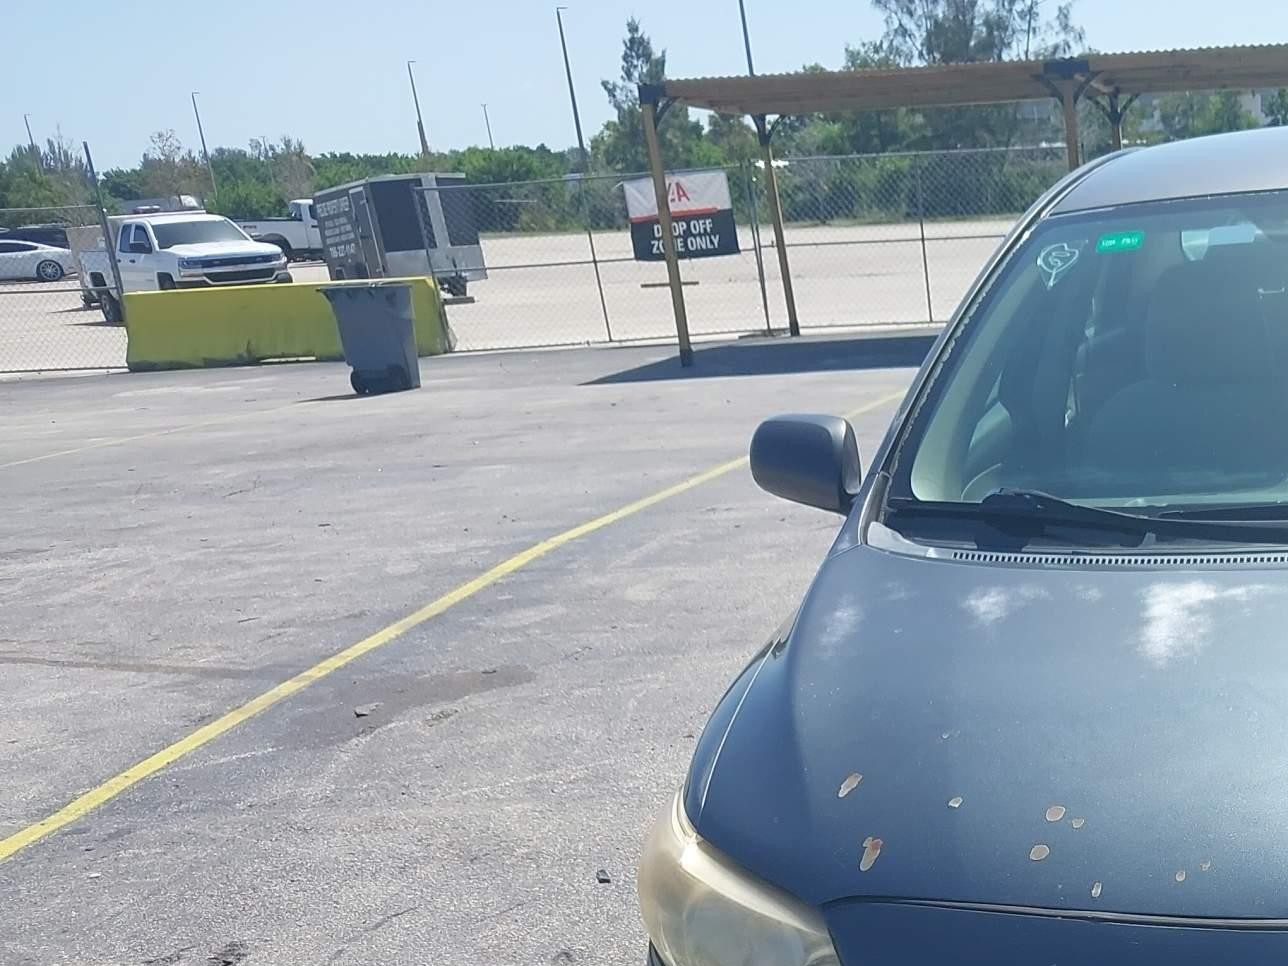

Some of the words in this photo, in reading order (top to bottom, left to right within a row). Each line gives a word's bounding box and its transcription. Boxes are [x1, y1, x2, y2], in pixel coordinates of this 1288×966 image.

[653, 222, 687, 238] DOP
[690, 219, 713, 235] OFF
[650, 238, 686, 254] ZOE
[687, 234, 720, 251] ONLY
